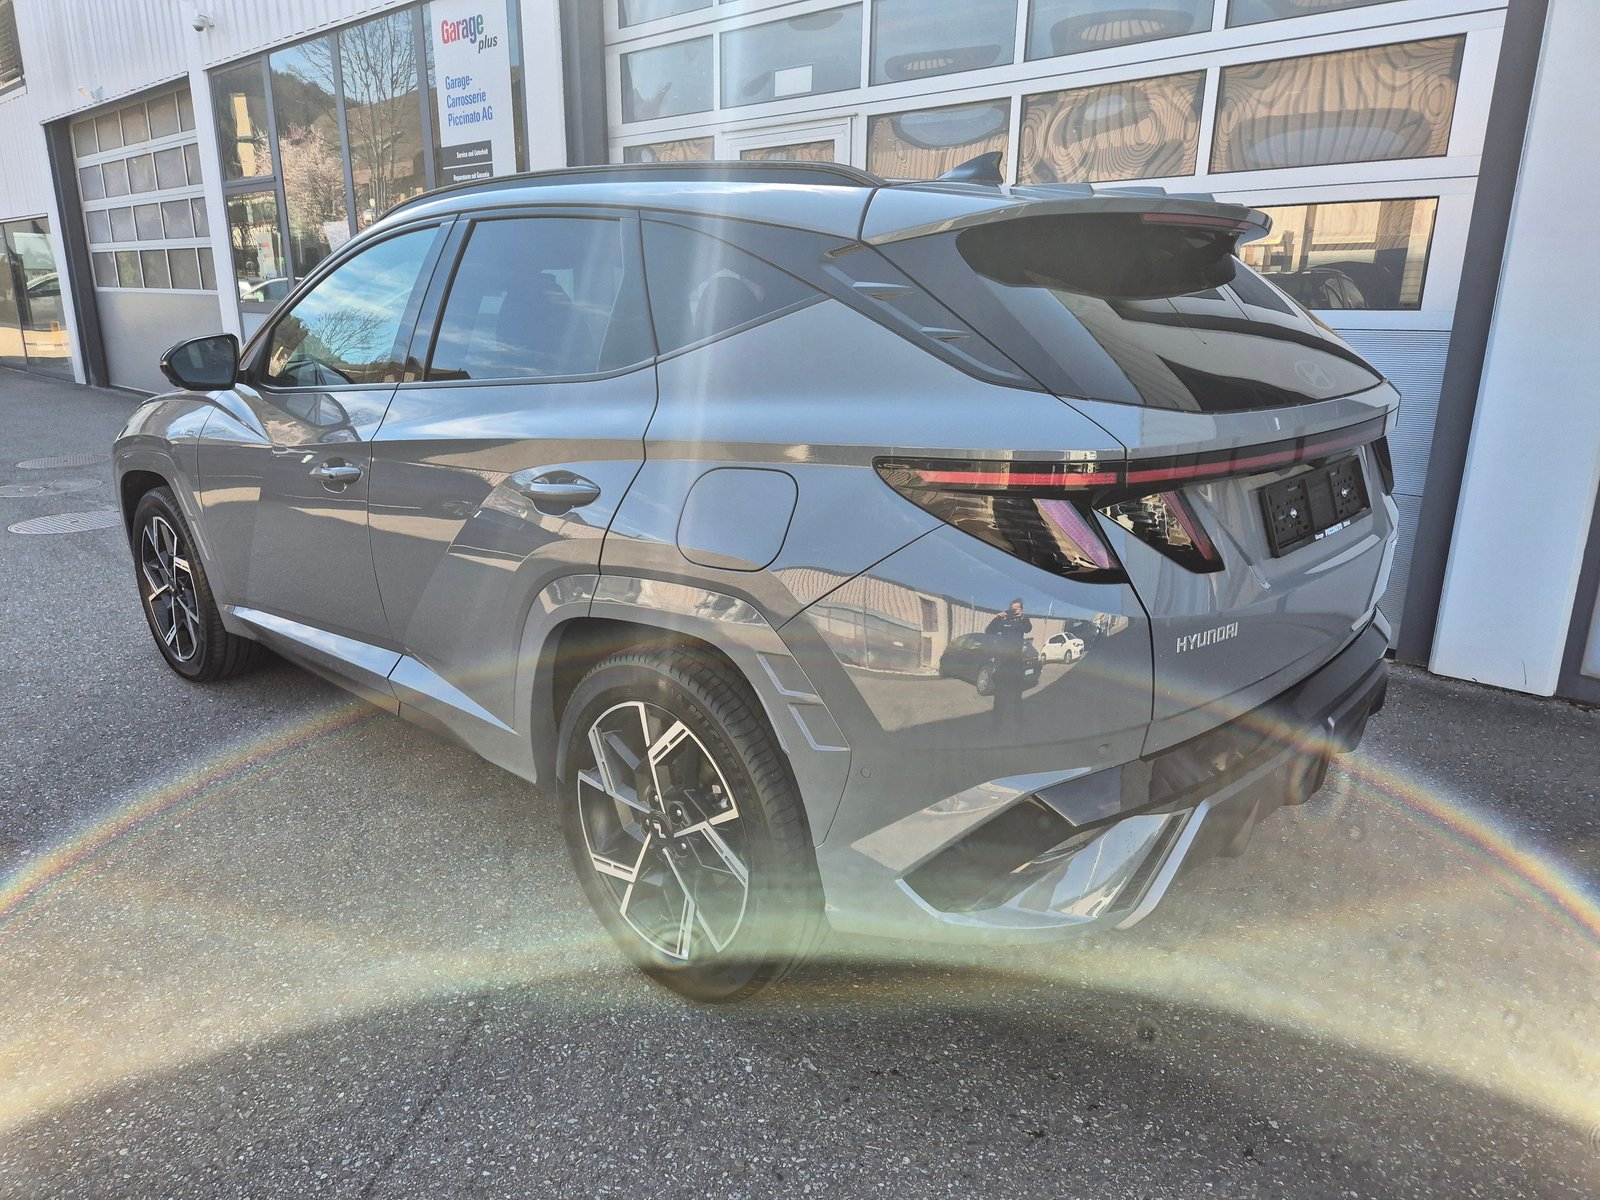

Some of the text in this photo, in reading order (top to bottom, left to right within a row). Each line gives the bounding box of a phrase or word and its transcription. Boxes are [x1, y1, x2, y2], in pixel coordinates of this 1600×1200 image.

[441, 14, 484, 44] Garage
[478, 35, 498, 53] plus
[445, 75, 473, 90] Garage-
[447, 89, 486, 109] Carrosserie
[448, 106, 493, 127] Piccinato AG
[1176, 622, 1239, 653] HYUNDAI
